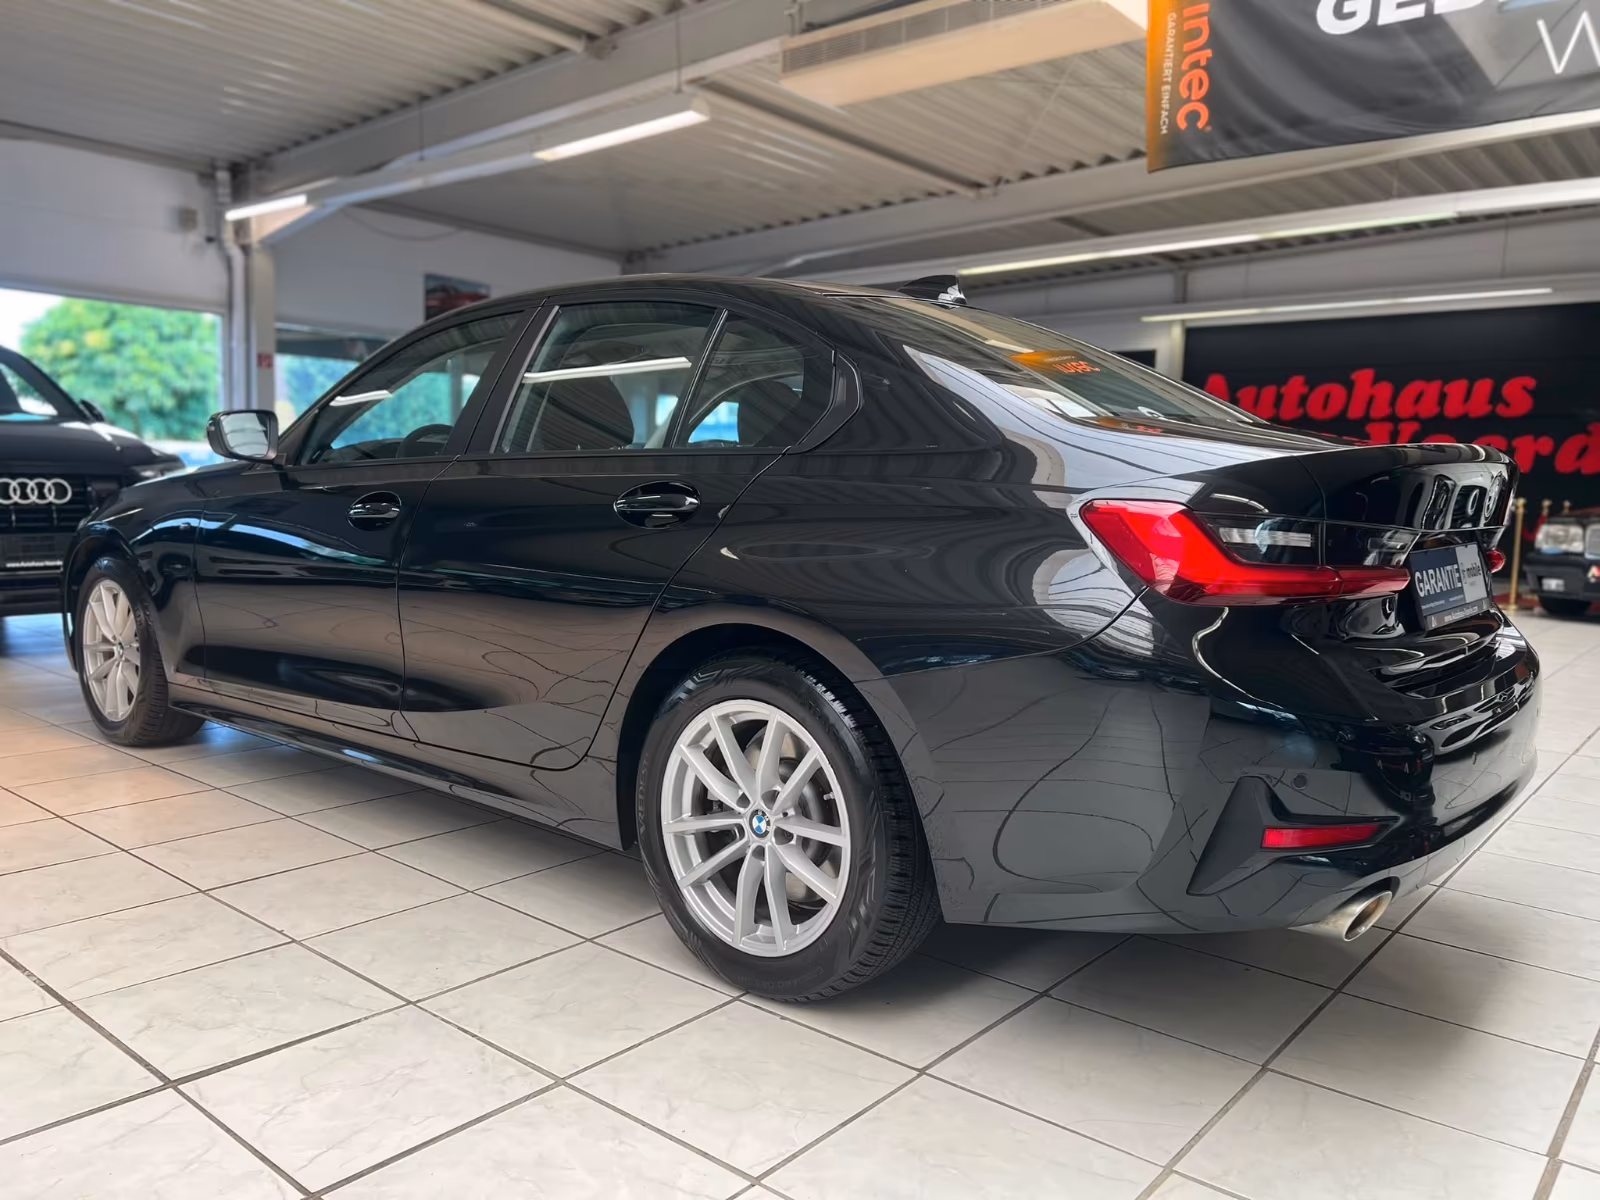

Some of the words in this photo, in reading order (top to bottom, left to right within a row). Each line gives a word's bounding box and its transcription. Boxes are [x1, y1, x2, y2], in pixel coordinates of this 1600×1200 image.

[1161, 12, 1177, 83] GARANTIERT
[1176, 3, 1212, 130] intec
[1160, 84, 1171, 135] EINFACH
[1415, 564, 1461, 598] GARANTIE
